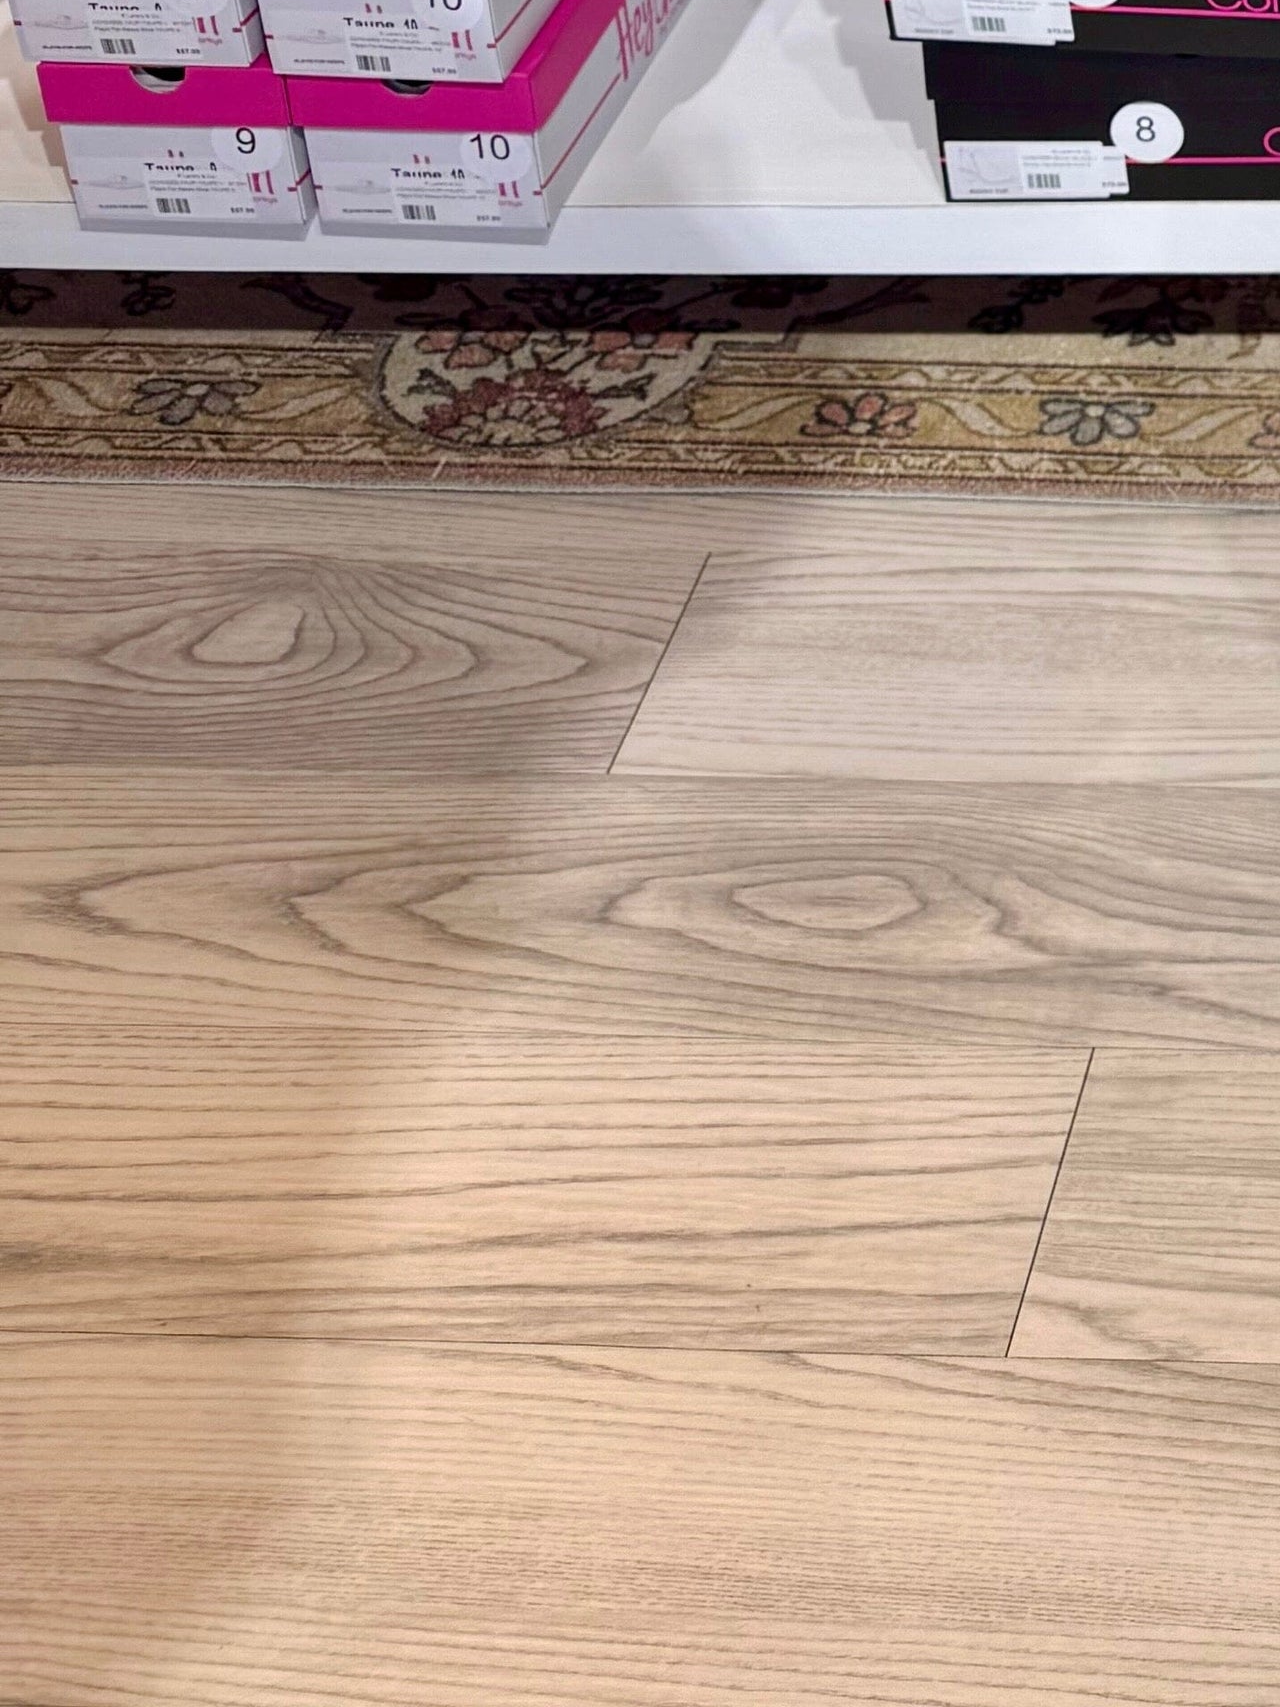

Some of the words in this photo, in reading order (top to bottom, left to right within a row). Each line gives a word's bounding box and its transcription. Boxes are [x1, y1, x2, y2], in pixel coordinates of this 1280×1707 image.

[235, 127, 257, 154] 9
[1135, 116, 1156, 143] 8
[469, 133, 511, 161] 10
